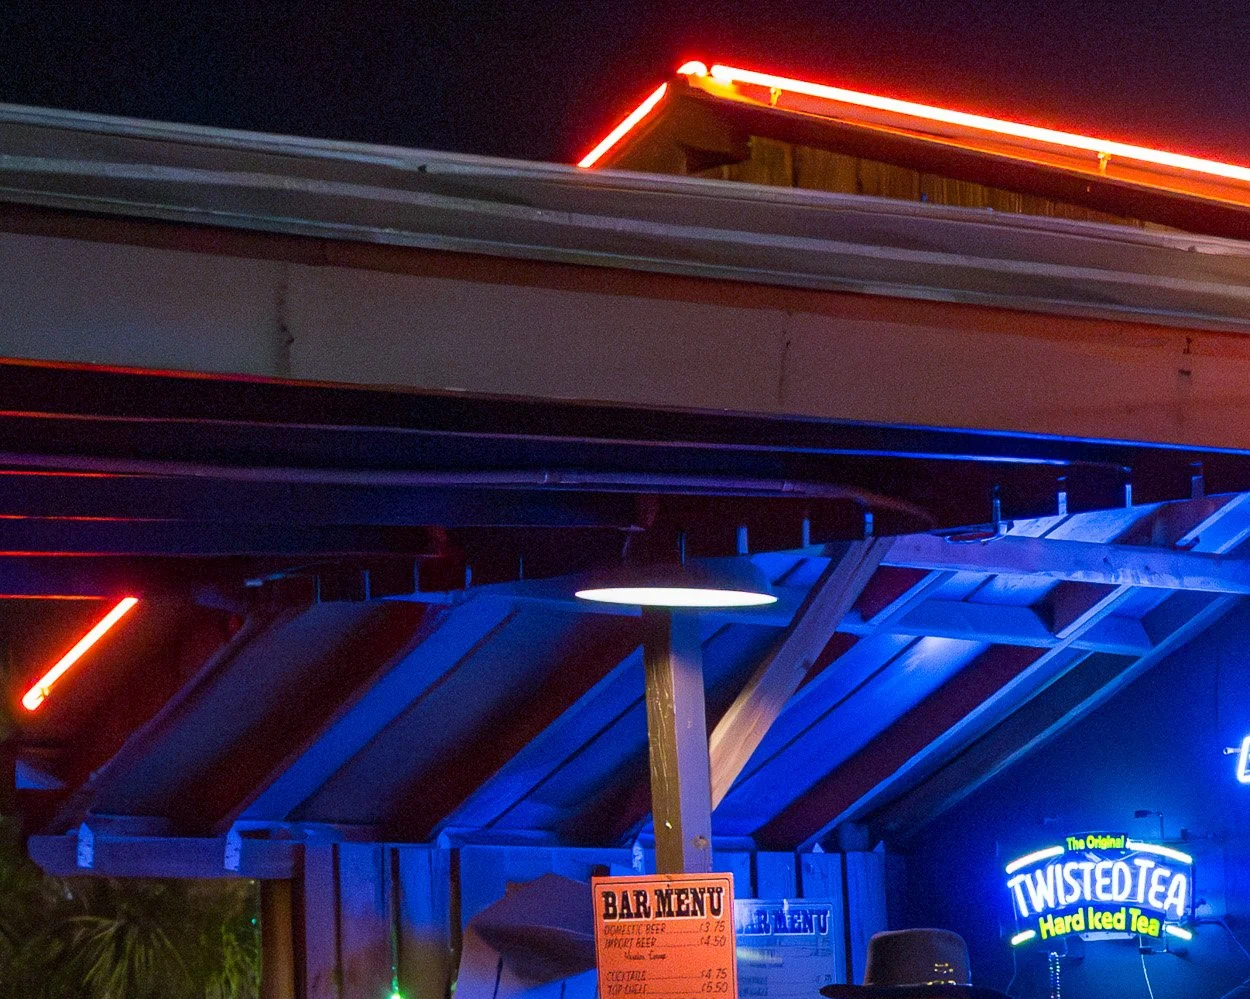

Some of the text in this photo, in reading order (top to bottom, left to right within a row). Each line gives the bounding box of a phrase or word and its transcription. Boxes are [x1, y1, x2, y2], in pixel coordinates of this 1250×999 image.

[1066, 835, 1125, 850] The Original
[1007, 858, 1187, 918] TWISTED TEA
[602, 886, 724, 920] BAR MENU
[645, 922, 666, 934] BEER
[736, 909, 830, 935] AR MENU
[1038, 907, 1161, 940] Hard Iced Tea
[635, 937, 657, 948] BEER
